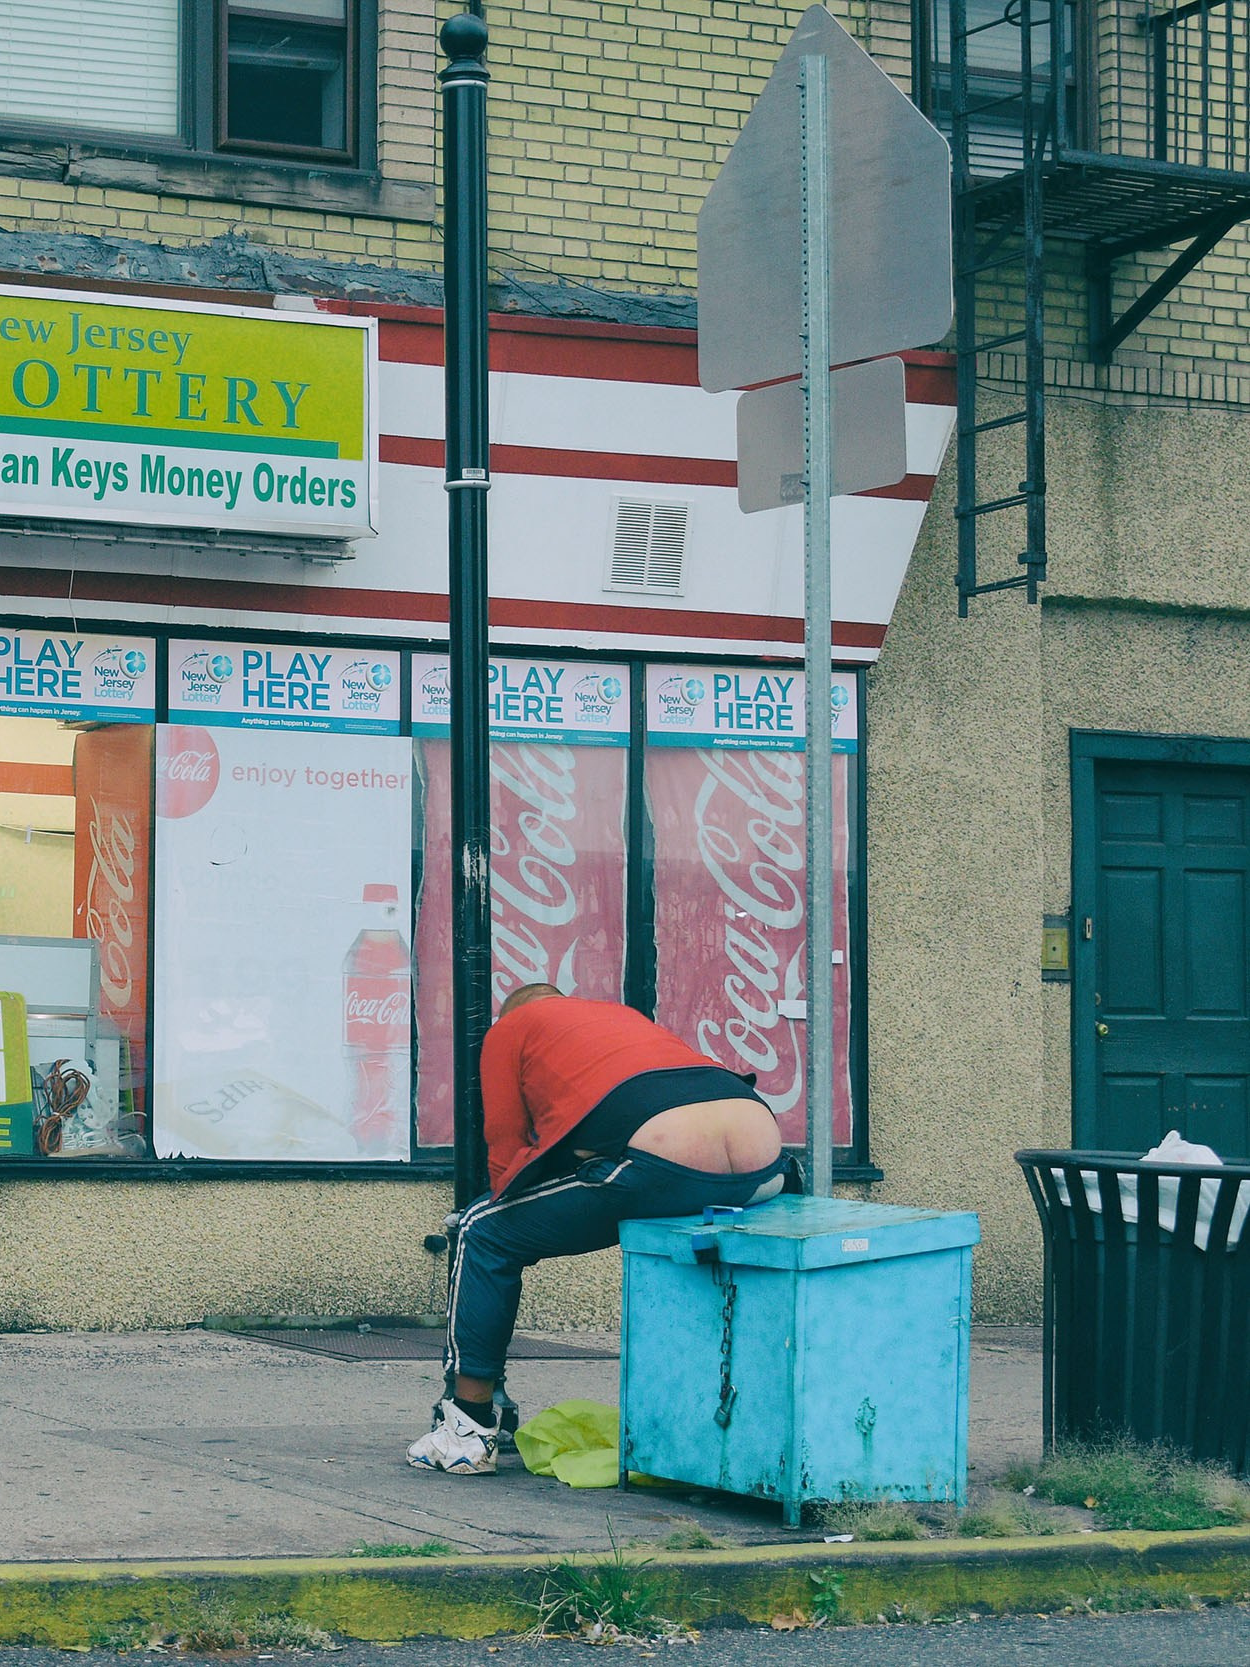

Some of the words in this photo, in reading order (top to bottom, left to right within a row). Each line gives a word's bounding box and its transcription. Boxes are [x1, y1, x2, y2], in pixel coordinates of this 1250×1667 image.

[66, 311, 193, 366] Jersey
[51, 447, 129, 501] Keys
[140, 454, 243, 510] Money
[252, 462, 357, 509] Orders
[94, 666, 119, 677] New
[243, 650, 332, 681] PLAY
[182, 670, 207, 682] New
[100, 677, 135, 691] Jersey
[187, 682, 222, 695] Jersey
[342, 679, 366, 690] New
[422, 684, 445, 695] New
[713, 674, 794, 703] PLAY
[243, 680, 330, 711] HERE
[347, 690, 381, 703] Jersey
[574, 692, 598, 703] New
[658, 694, 681, 704] New
[714, 702, 793, 731] HERE
[232, 763, 297, 787] enjoy
[305, 767, 409, 790] together
